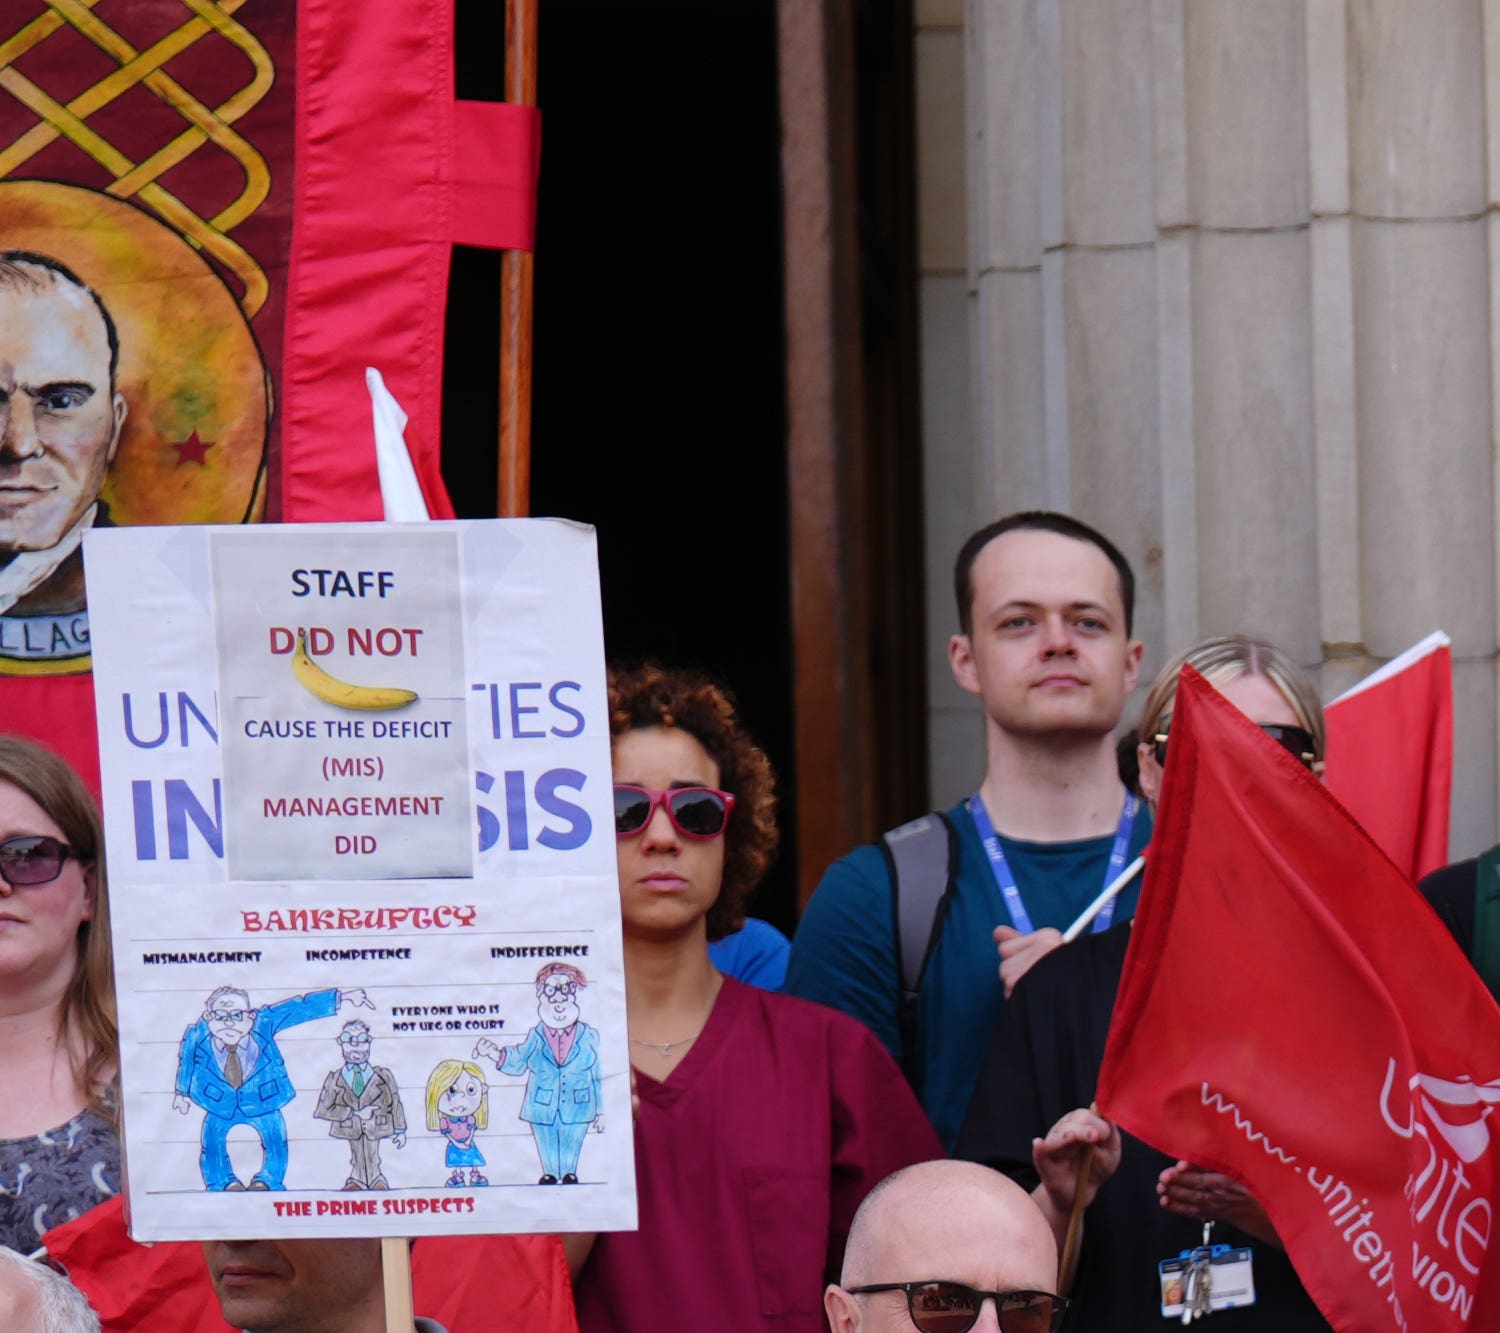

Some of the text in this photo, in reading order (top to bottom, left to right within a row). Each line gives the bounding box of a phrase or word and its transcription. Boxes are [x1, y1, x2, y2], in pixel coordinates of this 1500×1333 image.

[291, 569, 394, 598] STAFF
[348, 628, 423, 657] NOT
[244, 720, 452, 739] CAUSE THE DEFICIT
[322, 756, 384, 782] (MIS)
[263, 796, 444, 818] MANAGEMENT
[335, 835, 377, 855] DID
[240, 905, 477, 932] BANKRUPTCY
[142, 951, 263, 965] MISMANAGEMENT
[306, 948, 412, 962] INCOMPETENCE
[491, 945, 589, 959] INDIFFERENCE
[392, 1004, 500, 1017] EVERYONE WHO IS
[393, 1022, 416, 1032] NOT
[446, 1021, 462, 1031] OR
[465, 1020, 505, 1031] COURT
[273, 1197, 475, 1217] THE PRIME SUSPECTS
